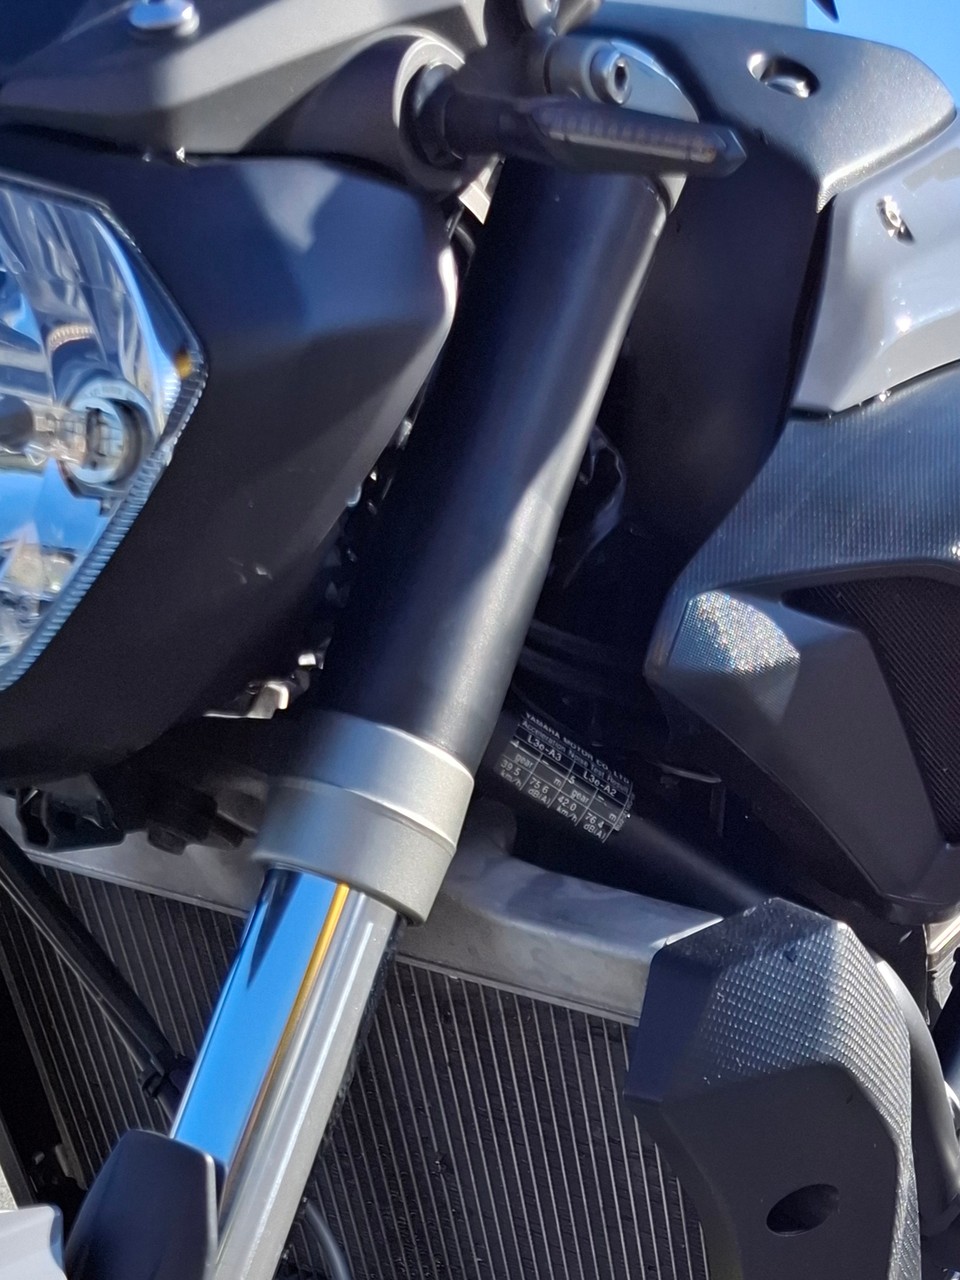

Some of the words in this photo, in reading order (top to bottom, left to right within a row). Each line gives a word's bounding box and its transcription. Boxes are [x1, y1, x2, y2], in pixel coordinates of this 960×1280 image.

[526, 712, 560, 738] YAMAHA
[563, 737, 593, 761] MOTOR
[528, 735, 562, 761] L3e-A3
[501, 760, 520, 775] 39.5
[514, 753, 534, 768] gear
[501, 770, 522, 787] km/h
[583, 772, 617, 797] L3e-A2
[571, 789, 590, 803] gear
[556, 806, 578, 822] km/h
